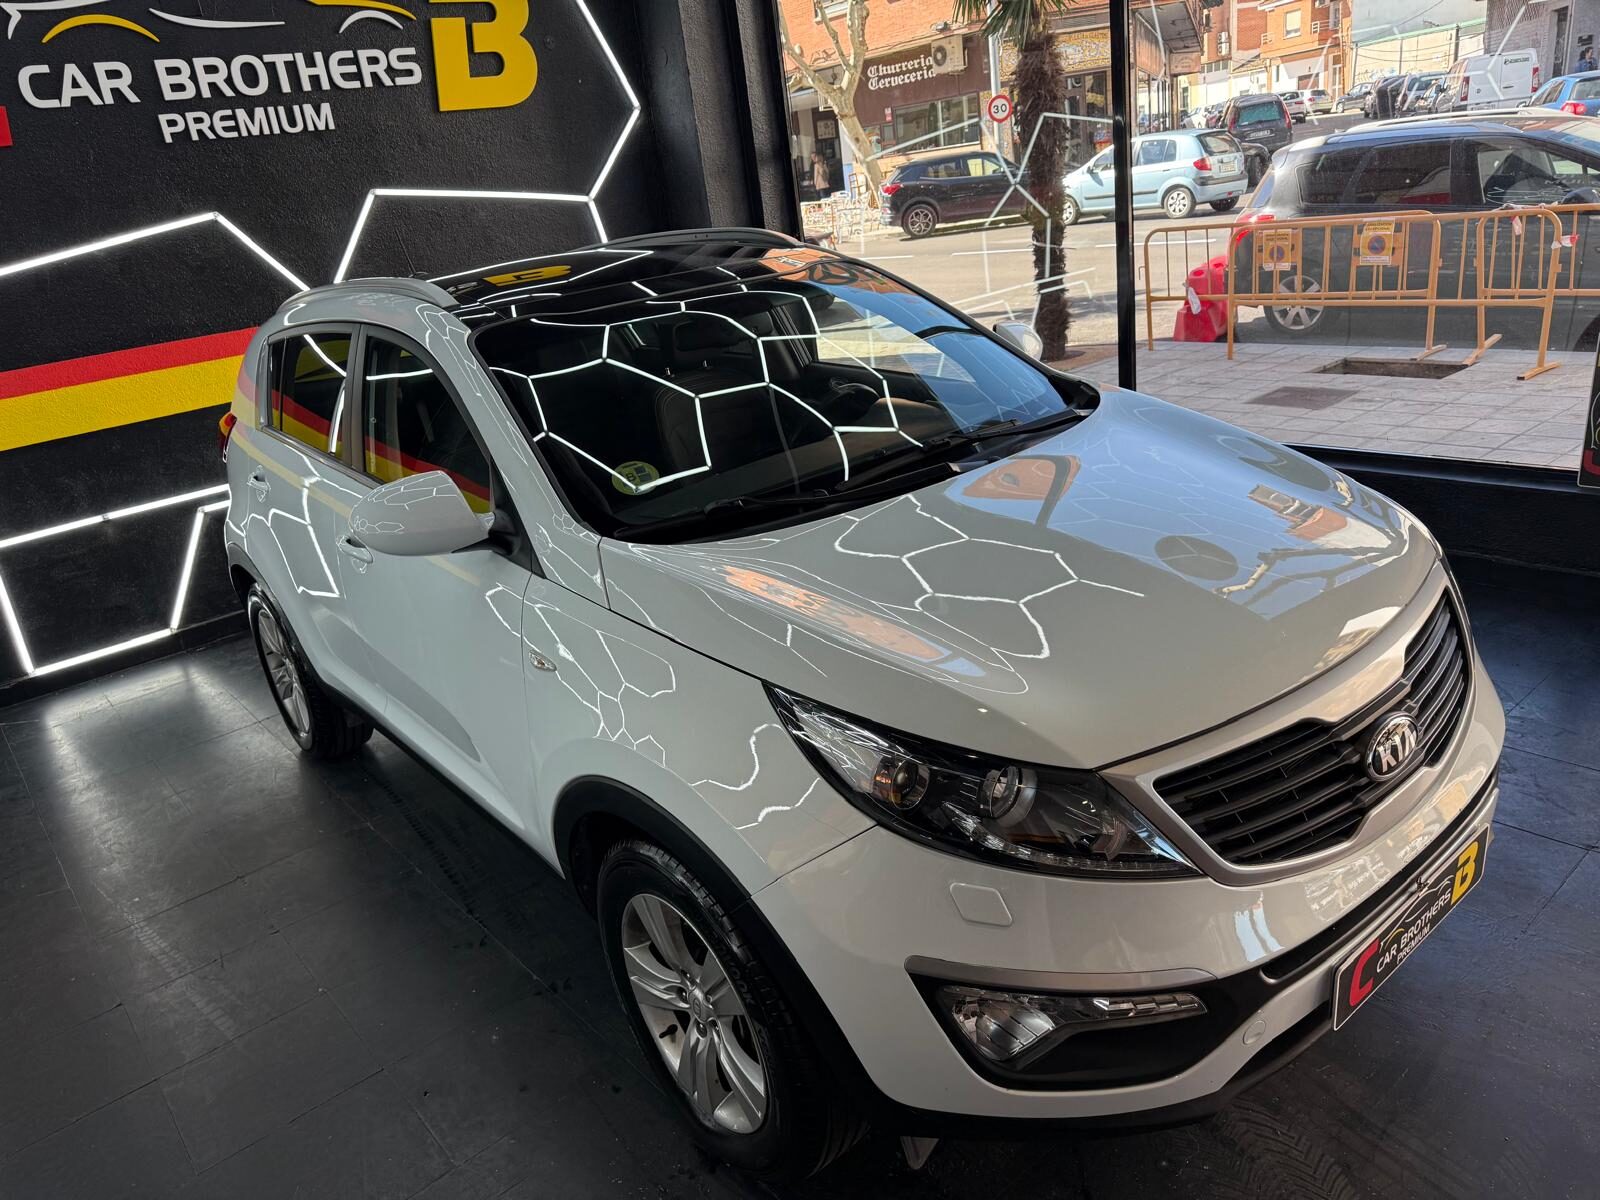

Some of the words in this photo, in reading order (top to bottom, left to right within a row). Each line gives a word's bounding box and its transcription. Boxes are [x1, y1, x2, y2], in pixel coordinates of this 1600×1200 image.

[18, 61, 141, 109] CAR
[154, 47, 423, 101] BROTHERS
[158, 103, 335, 143] PREMIUM
[993, 103, 1008, 114] 30
[1376, 725, 1417, 773] KIA
[1451, 840, 1479, 906] B
[1376, 944, 1398, 973] CAR
[1400, 888, 1452, 948] BROTHERS
[1396, 923, 1431, 965] PREMIUM
